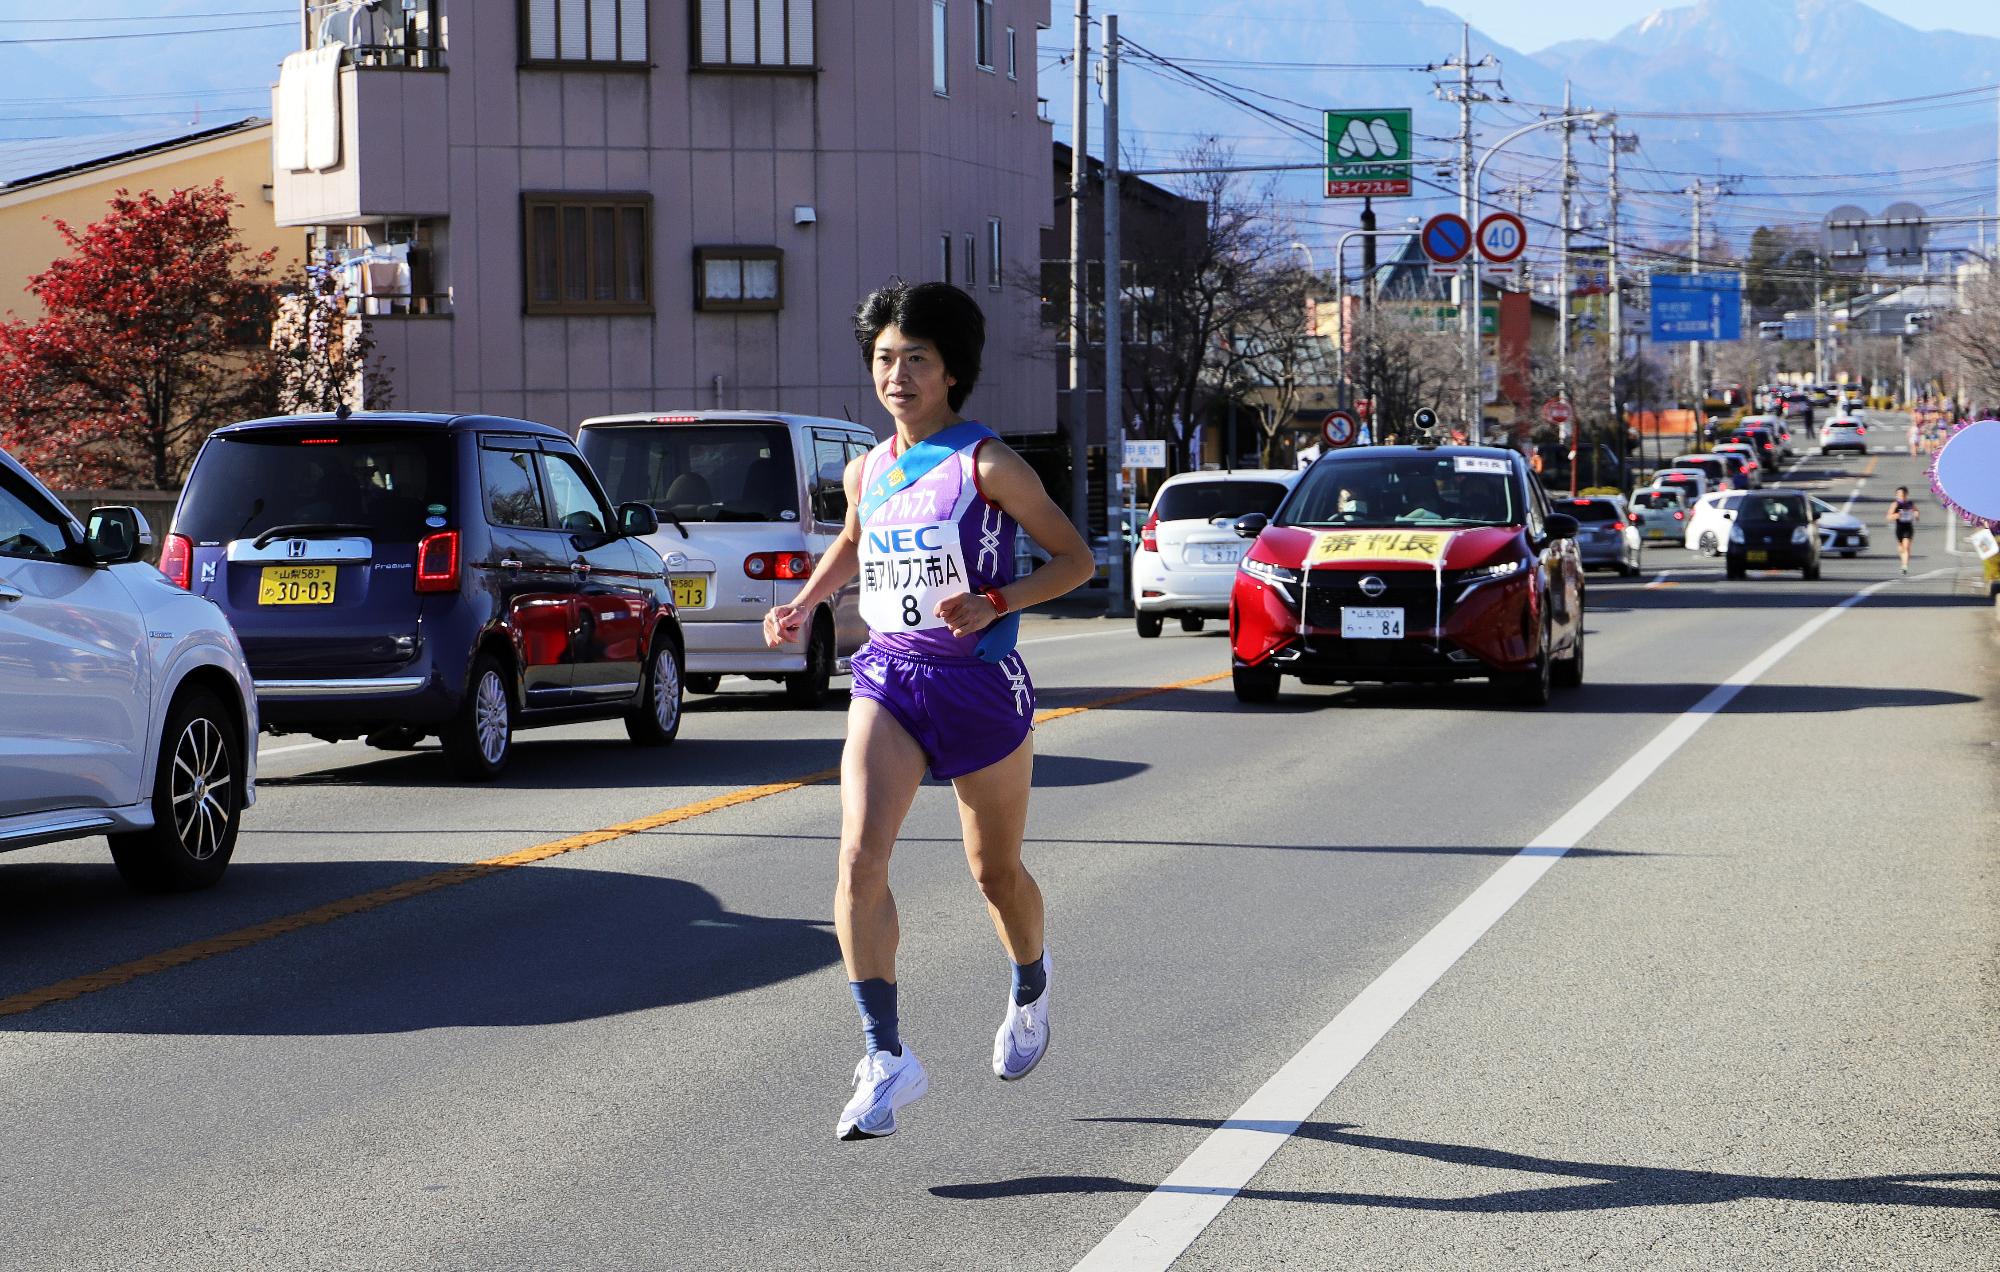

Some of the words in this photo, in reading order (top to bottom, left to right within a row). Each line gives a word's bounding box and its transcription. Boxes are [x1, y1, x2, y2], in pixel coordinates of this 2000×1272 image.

[1487, 227, 1515, 249] 40
[868, 526, 943, 554] NEC
[1321, 534, 1440, 554] 審判長
[202, 561, 216, 576] N
[864, 553, 962, 592] 南アルプス市A
[277, 582, 331, 600] 30-03
[901, 594, 922, 627] 8
[1382, 620, 1400, 635] 84
